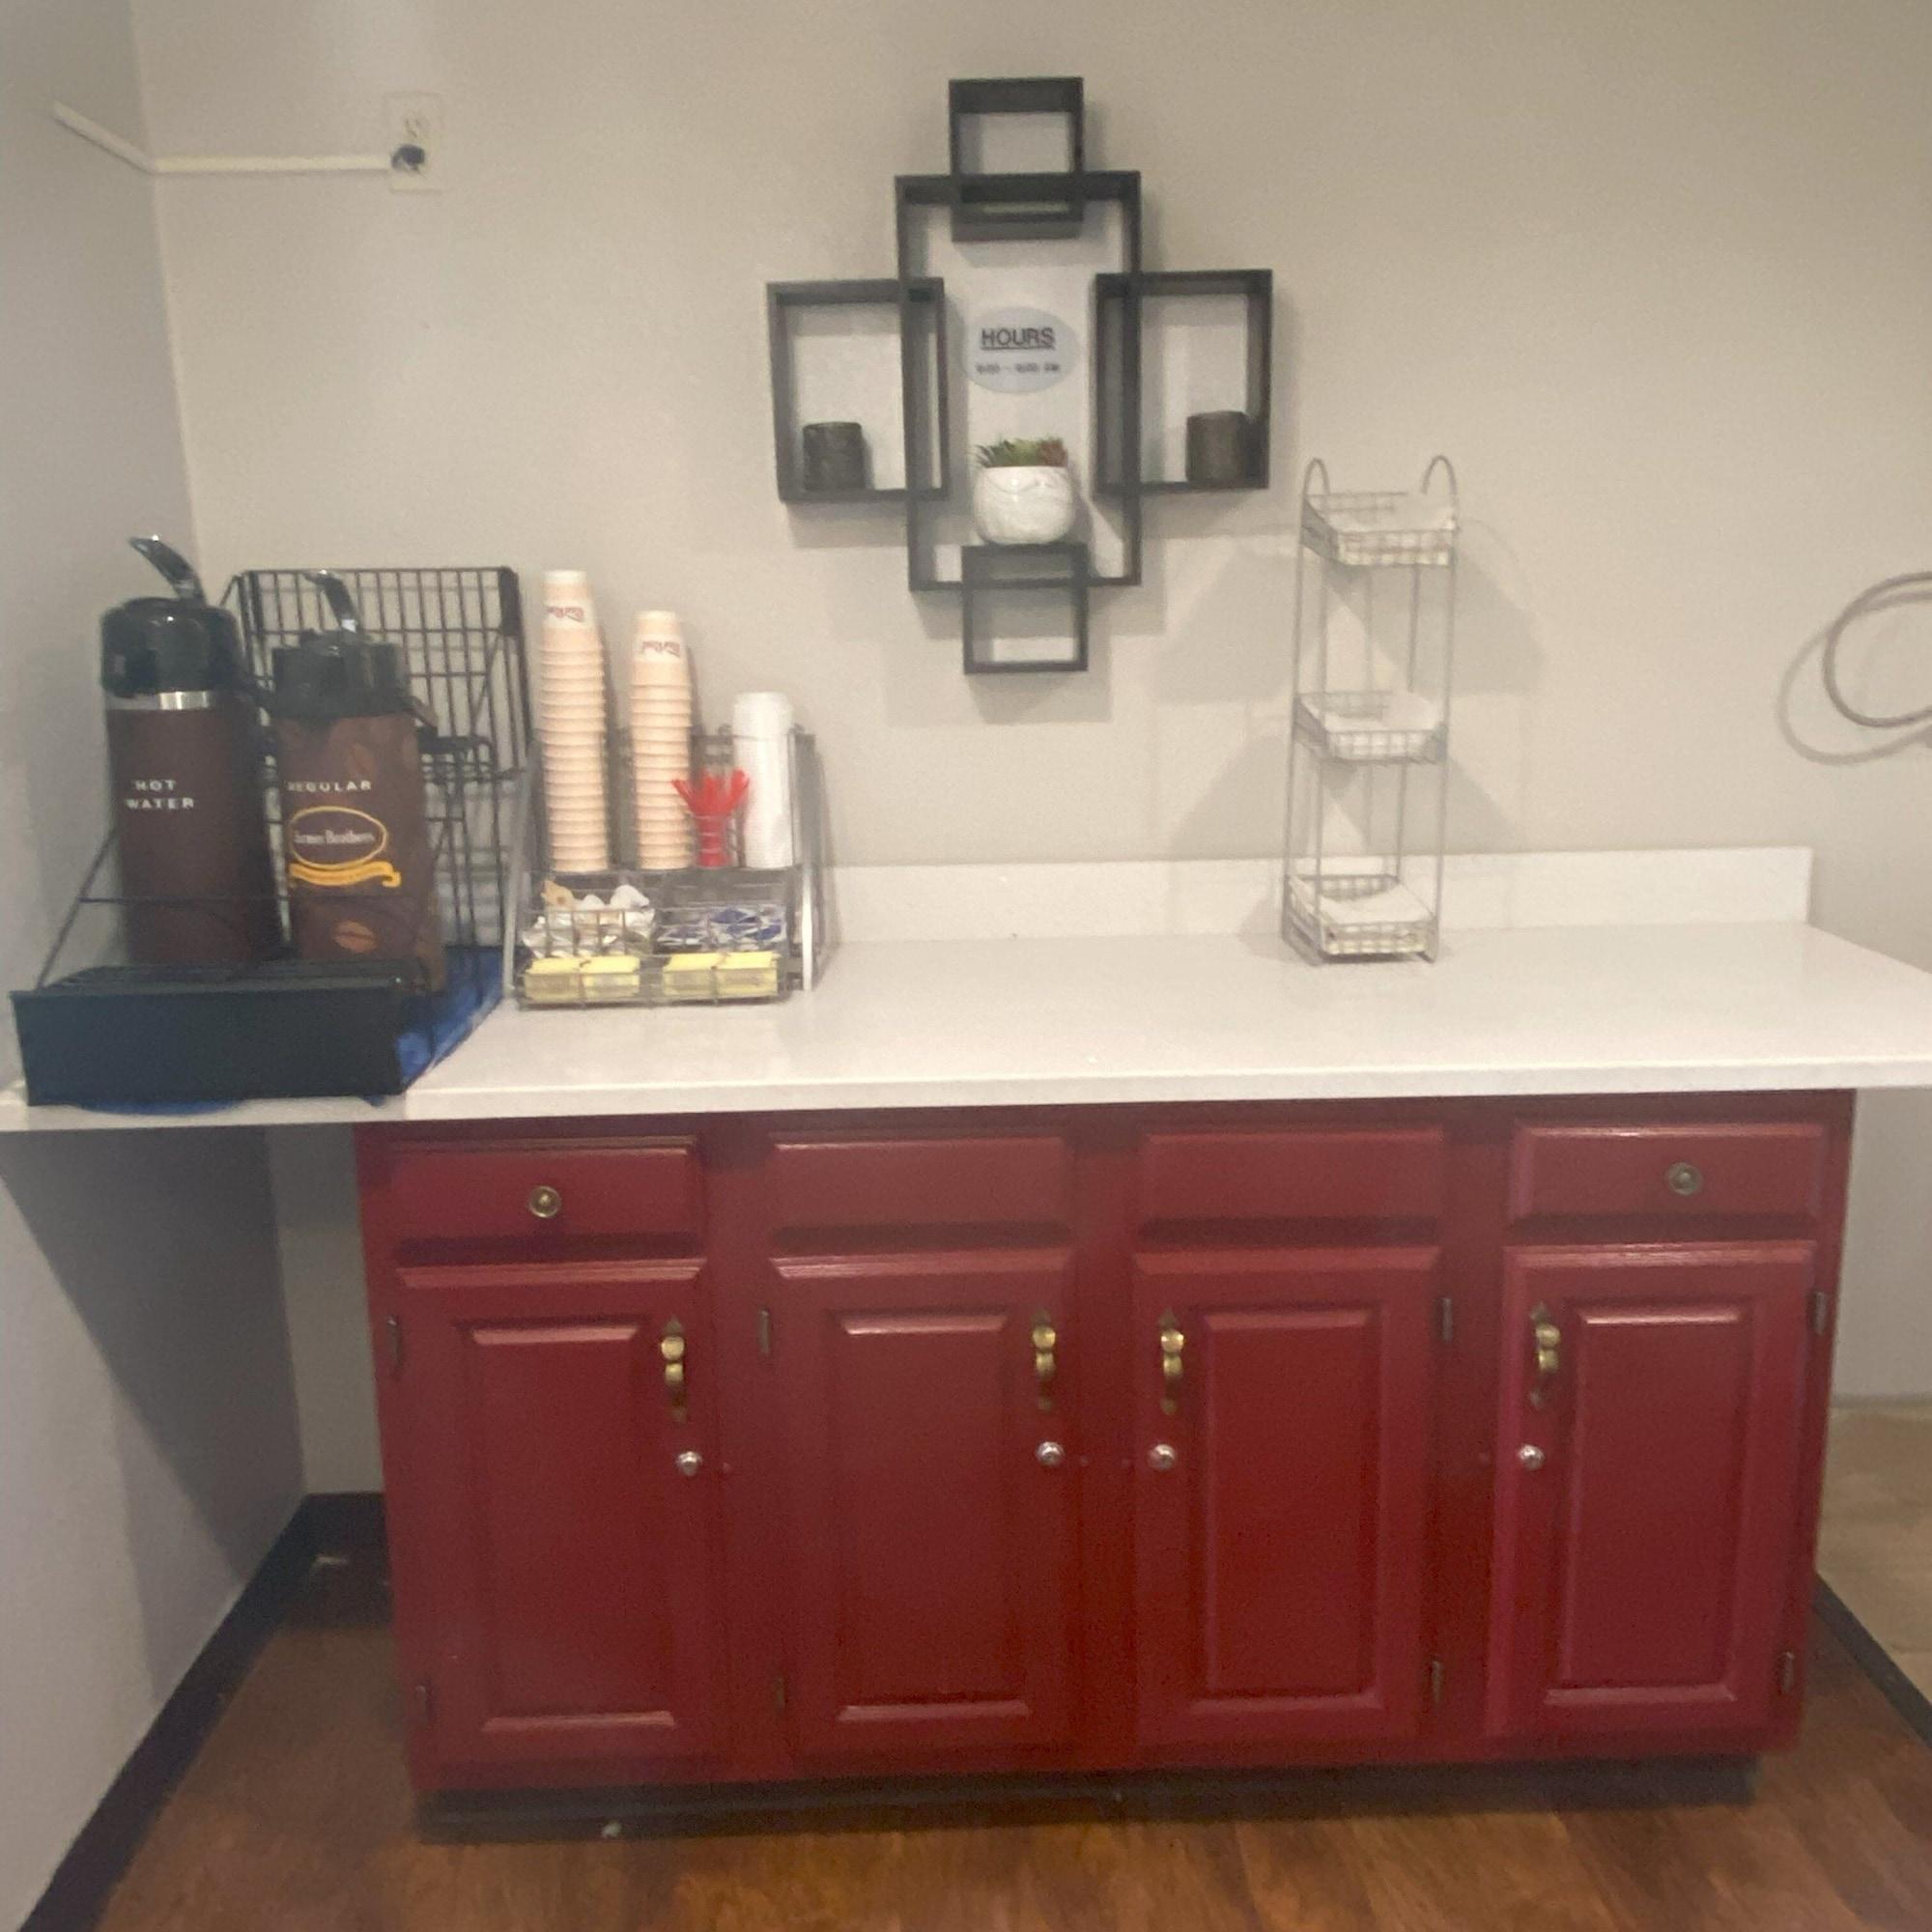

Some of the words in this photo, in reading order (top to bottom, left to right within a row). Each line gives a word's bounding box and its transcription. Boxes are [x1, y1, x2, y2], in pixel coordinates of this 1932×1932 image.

[980, 327, 1056, 348] HOURS
[134, 779, 177, 791] HOT
[287, 780, 372, 792] REGULAR
[126, 797, 195, 810] WATER
